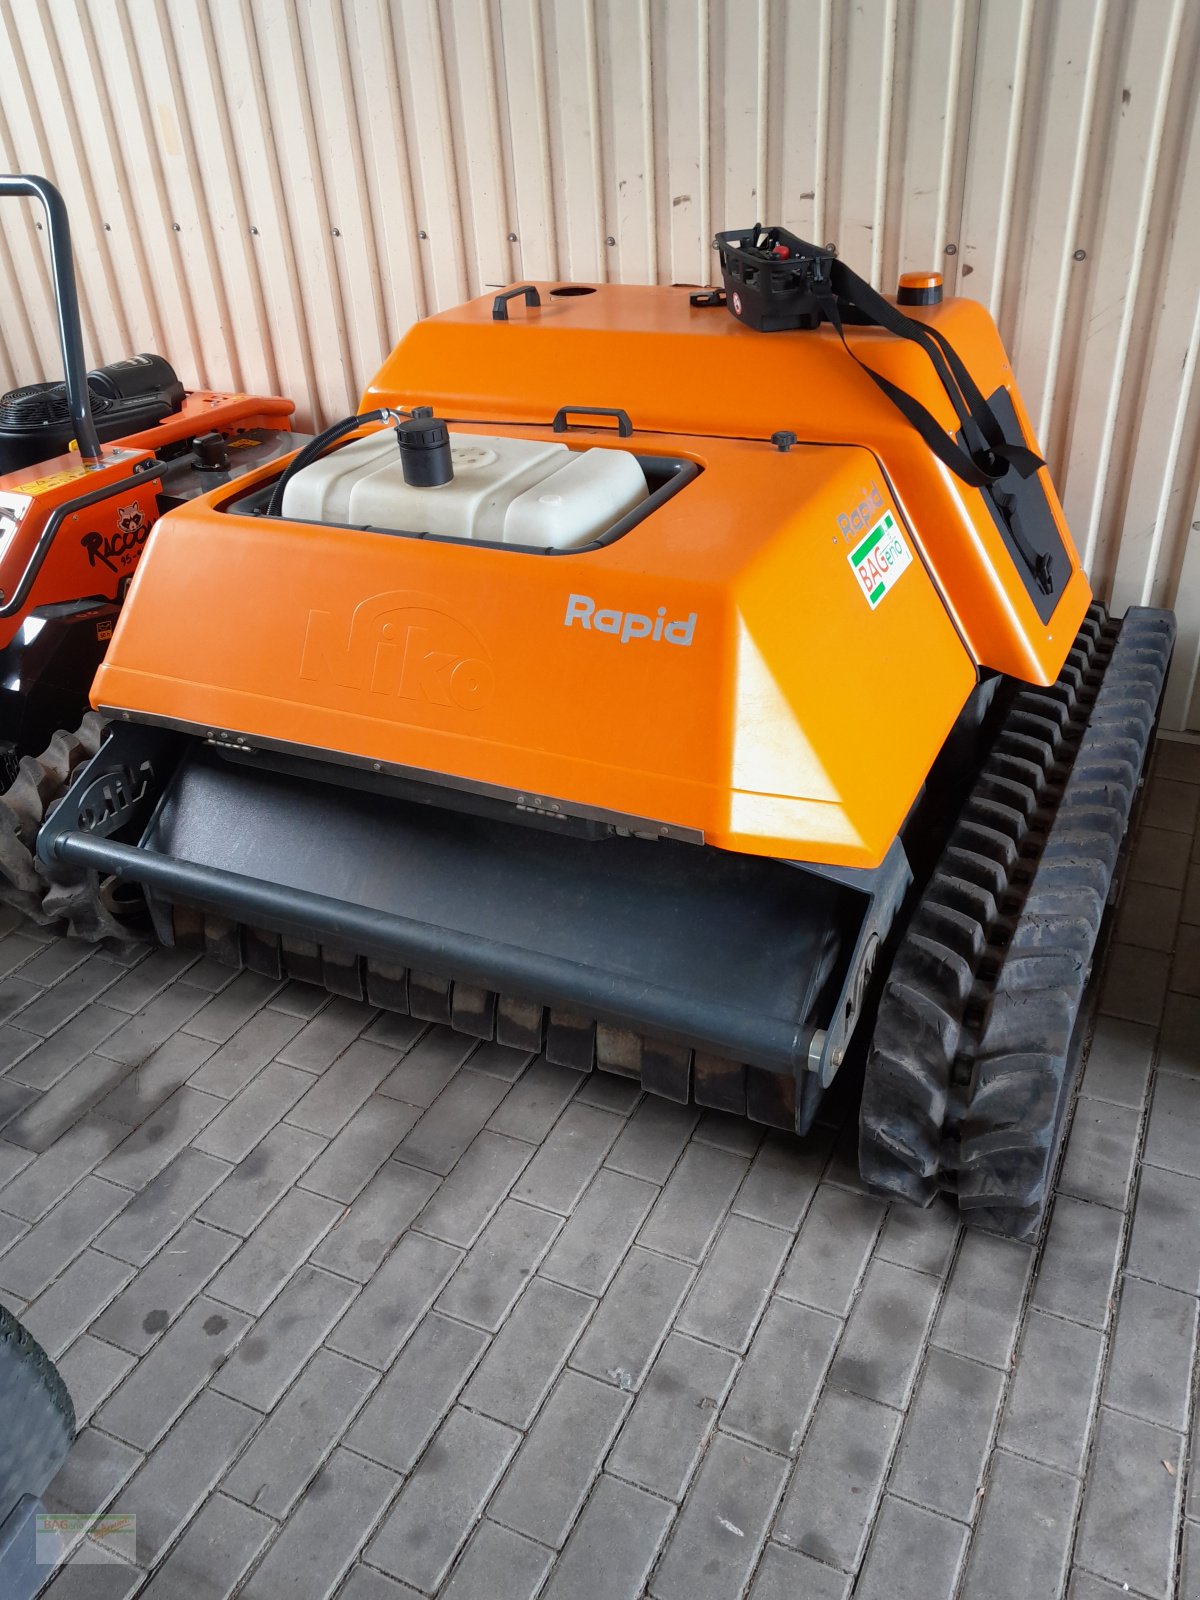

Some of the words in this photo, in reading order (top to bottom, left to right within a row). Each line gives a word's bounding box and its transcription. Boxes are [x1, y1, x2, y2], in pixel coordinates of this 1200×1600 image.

[836, 480, 884, 542] Rapid
[299, 589, 494, 711] Niko
[564, 593, 698, 646] Rapid
